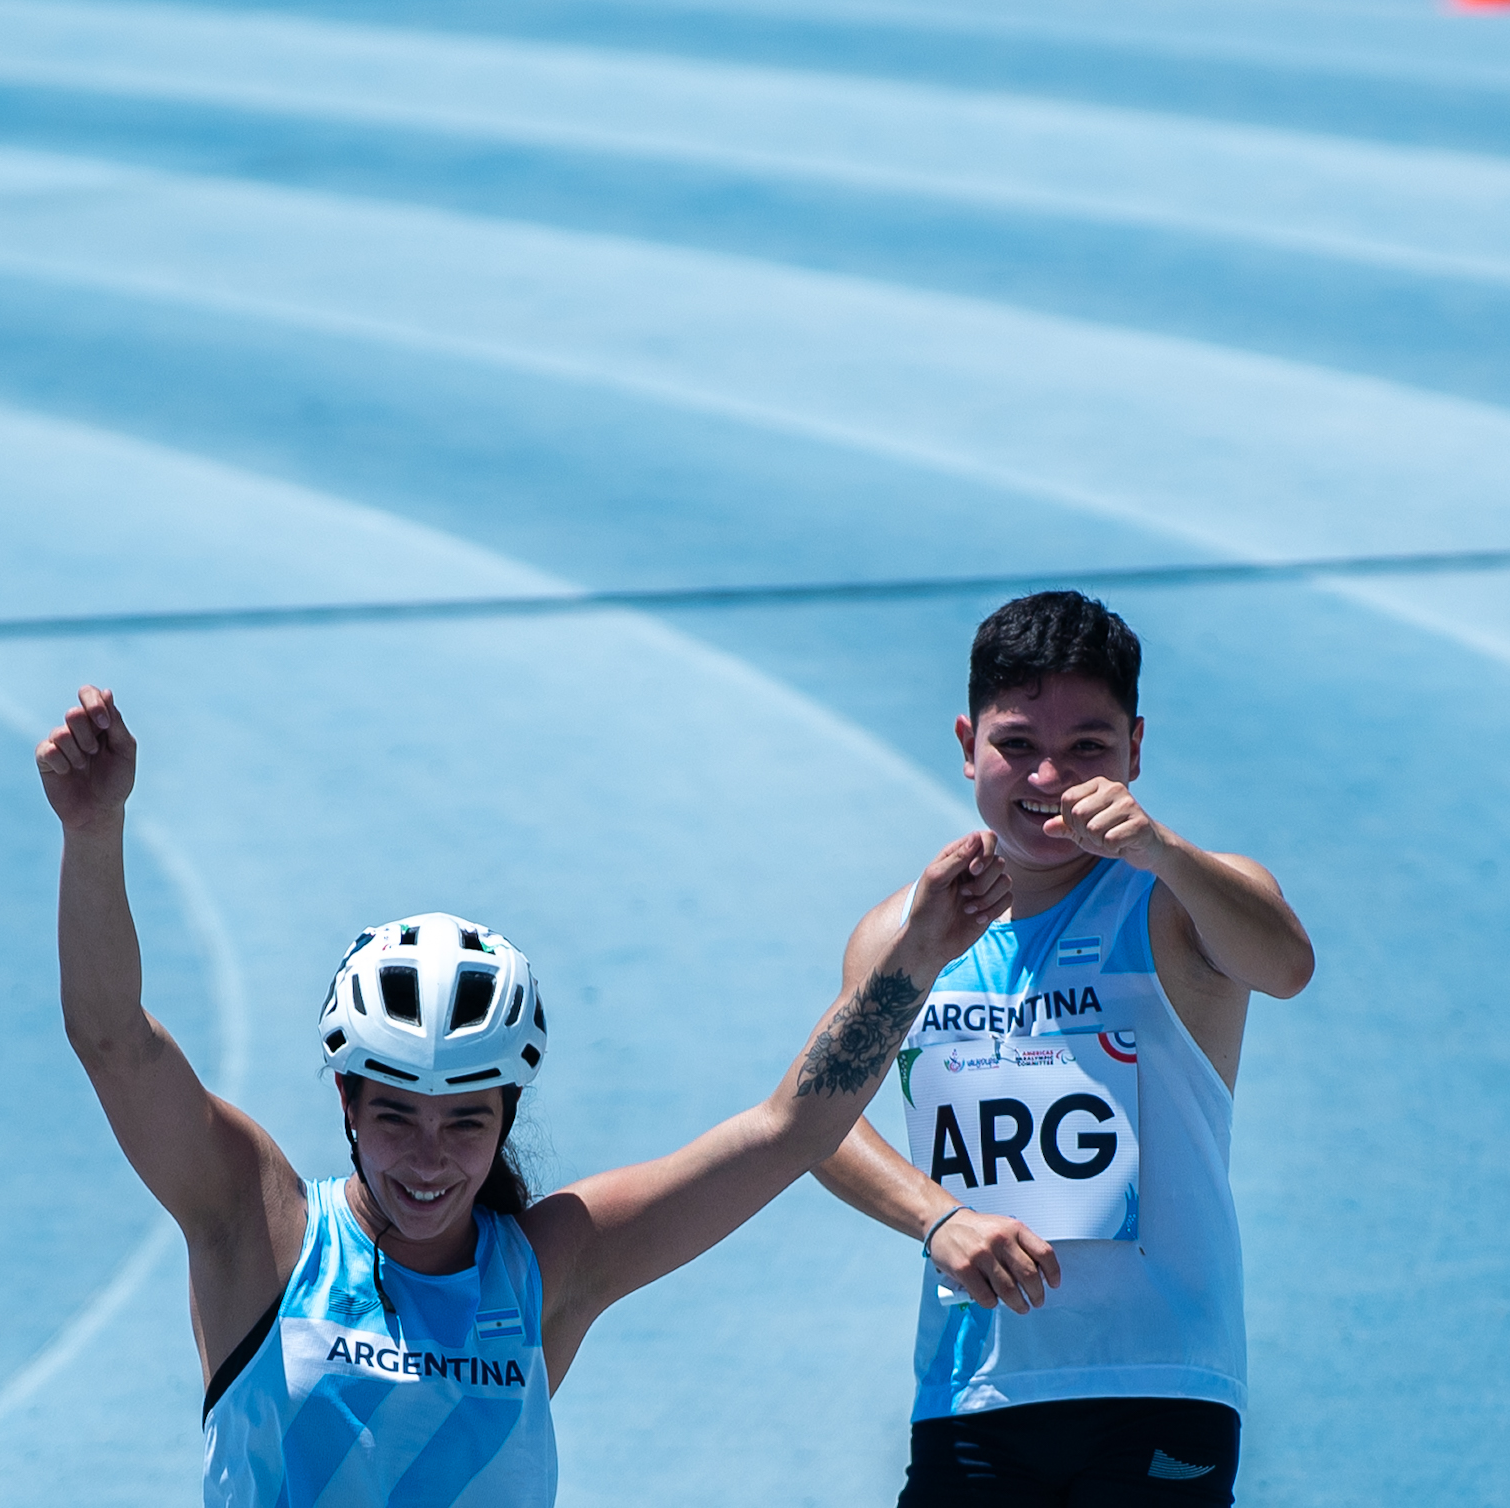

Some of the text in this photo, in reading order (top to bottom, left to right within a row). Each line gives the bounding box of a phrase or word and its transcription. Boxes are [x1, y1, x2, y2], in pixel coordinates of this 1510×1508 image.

[922, 986, 1102, 1034] ARGENTINA
[930, 1093, 1118, 1189] ARG
[326, 1336, 526, 1388] ARGENTINA
